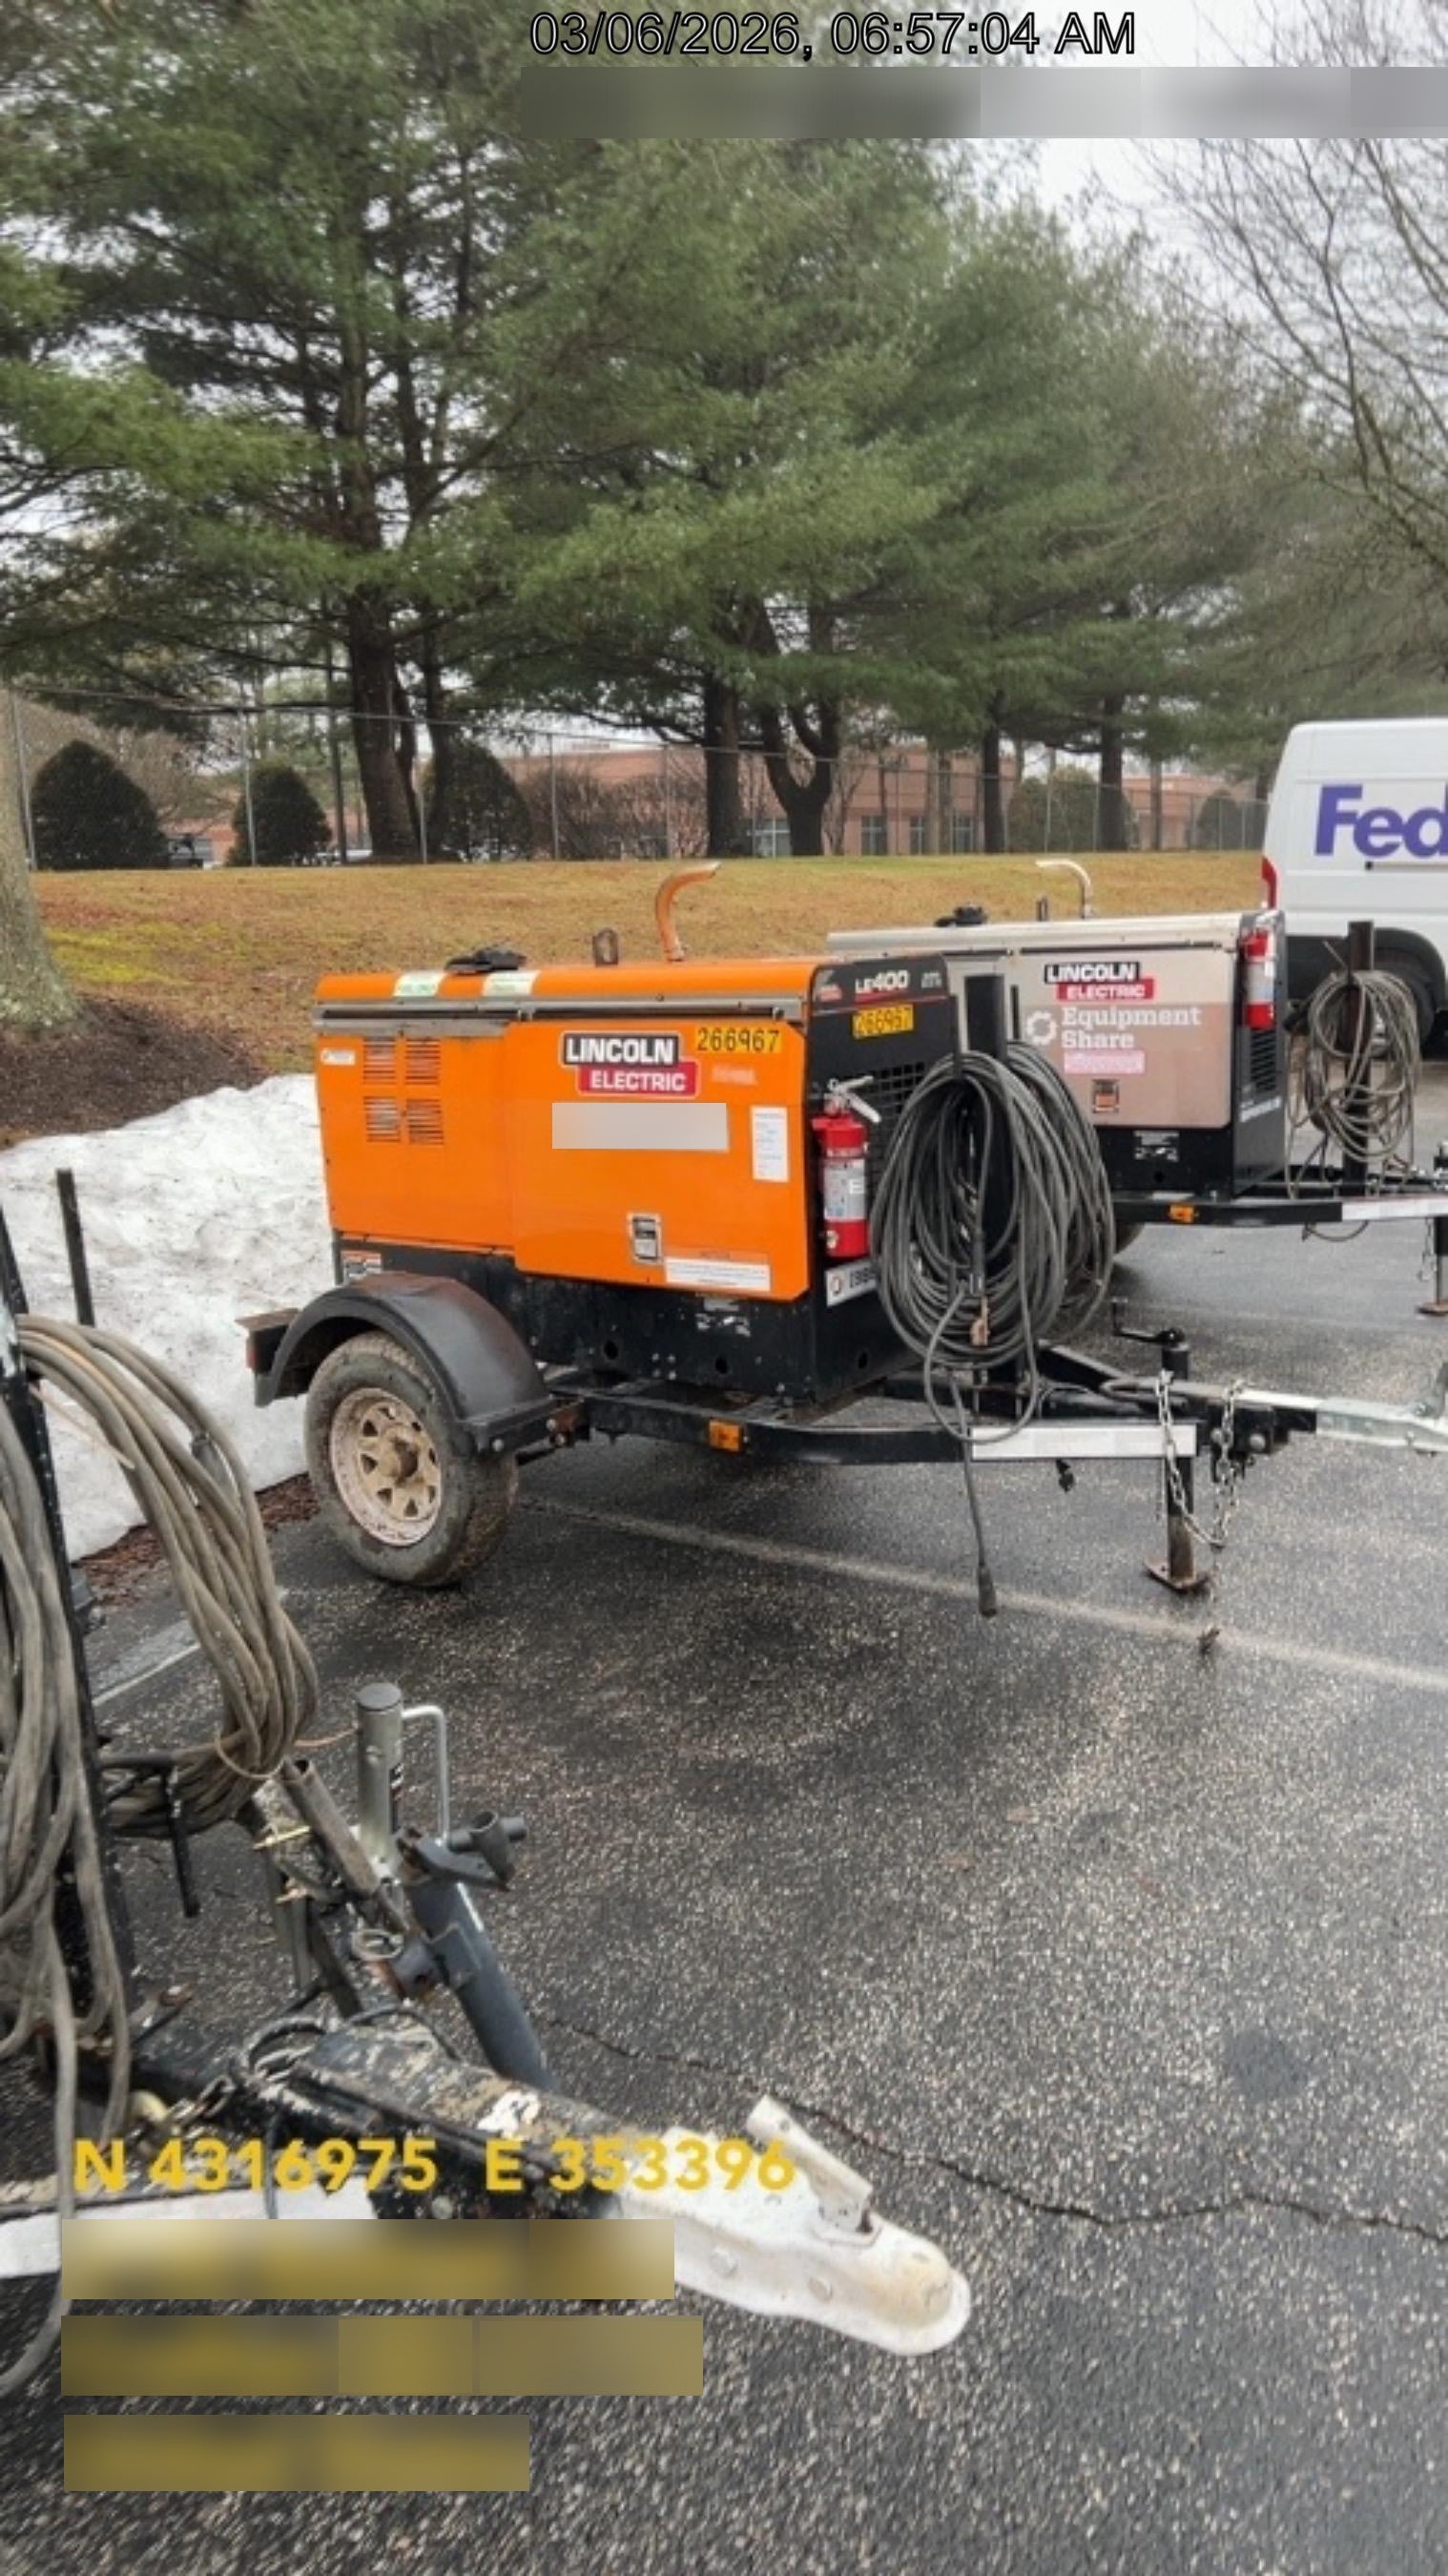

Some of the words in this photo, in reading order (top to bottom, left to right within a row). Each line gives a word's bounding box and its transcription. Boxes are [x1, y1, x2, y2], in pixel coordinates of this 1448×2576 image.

[1047, 963, 1136, 984] LINCOLN
[1065, 983, 1147, 1001] ELECTRIC
[1060, 1007, 1203, 1031] Equipment
[696, 1027, 780, 1052] 266967
[1060, 1029, 1135, 1049] Share
[566, 1037, 674, 1066] LINCOLN
[589, 1070, 688, 1092] ELECTRIC
